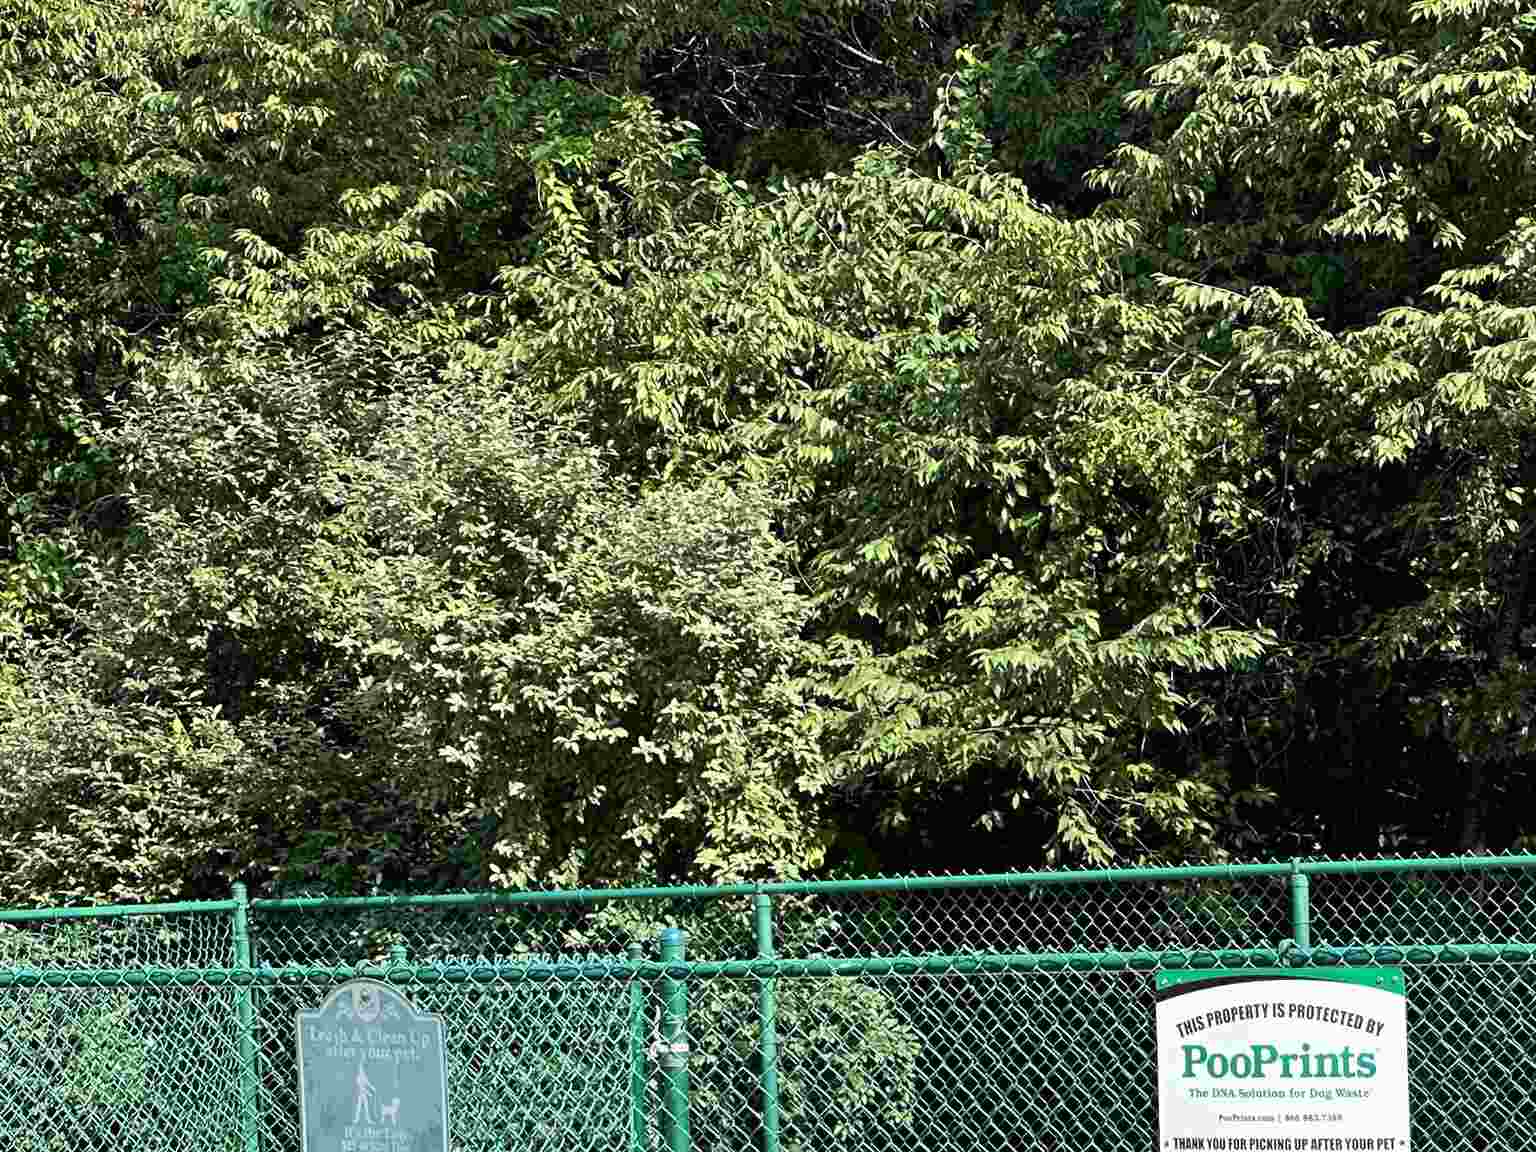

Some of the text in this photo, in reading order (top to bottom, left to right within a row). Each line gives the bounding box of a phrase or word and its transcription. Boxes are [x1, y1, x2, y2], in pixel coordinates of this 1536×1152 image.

[1176, 1003, 1384, 1038] THIS PROPERTY IS PROTECTED BY
[1181, 1043, 1377, 1079] PooPrints
[1188, 1088, 1369, 1100] The DNA Solution for Dog Waste
[1173, 1137, 1395, 1151] THANK YOU FOR PICKING UP AFTER YOUR PET
